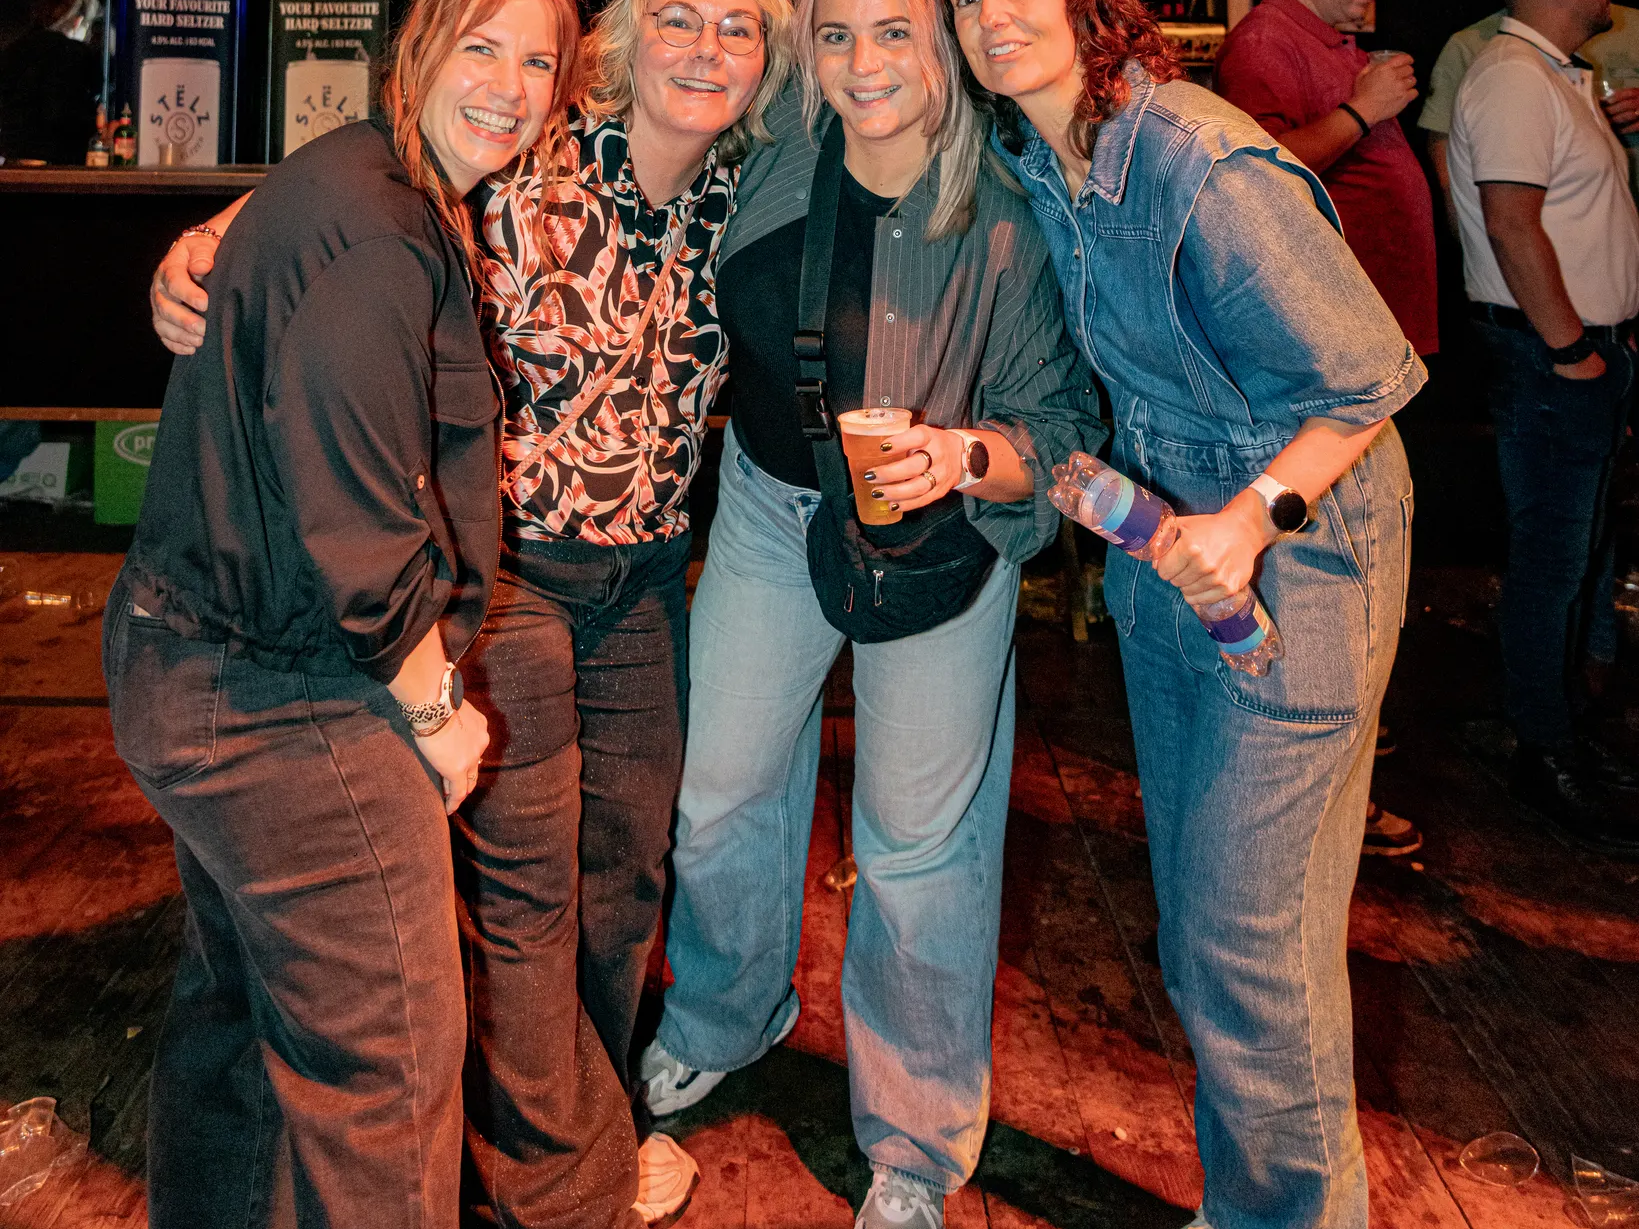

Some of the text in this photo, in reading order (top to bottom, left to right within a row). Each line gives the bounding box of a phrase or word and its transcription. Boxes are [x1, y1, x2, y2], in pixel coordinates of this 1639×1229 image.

[279, 1, 380, 16] YOUR FAVOURITE
[139, 11, 225, 29] HARD SELTZER
[285, 17, 373, 31] HARD SELTZER
